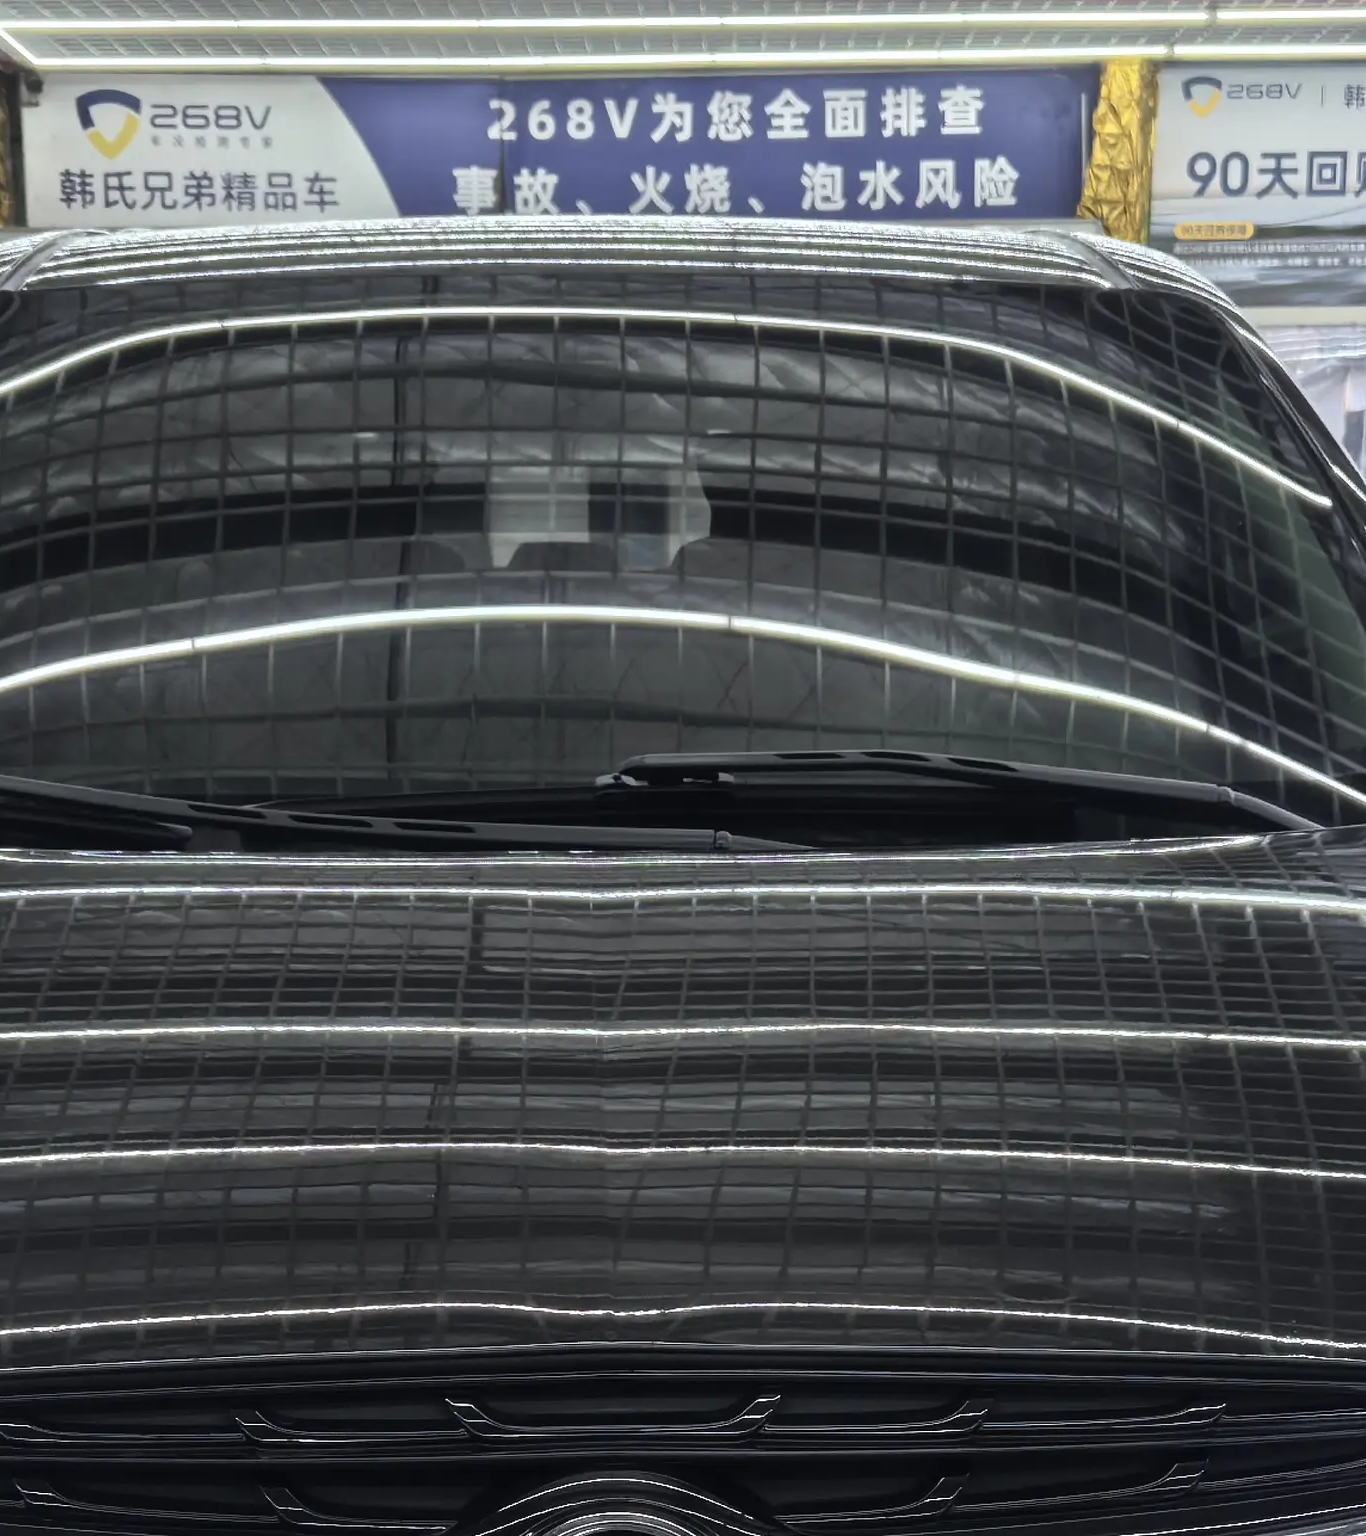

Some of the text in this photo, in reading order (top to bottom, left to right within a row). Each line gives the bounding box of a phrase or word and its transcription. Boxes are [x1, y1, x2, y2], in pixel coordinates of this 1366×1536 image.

[486, 85, 985, 142] 268V为您全面排查
[1226, 83, 1303, 100] 268V
[149, 104, 272, 130] 268V
[59, 169, 339, 213] 韩氏兄弟精品车
[451, 154, 1020, 216] 事故、火烧、泡水风险
